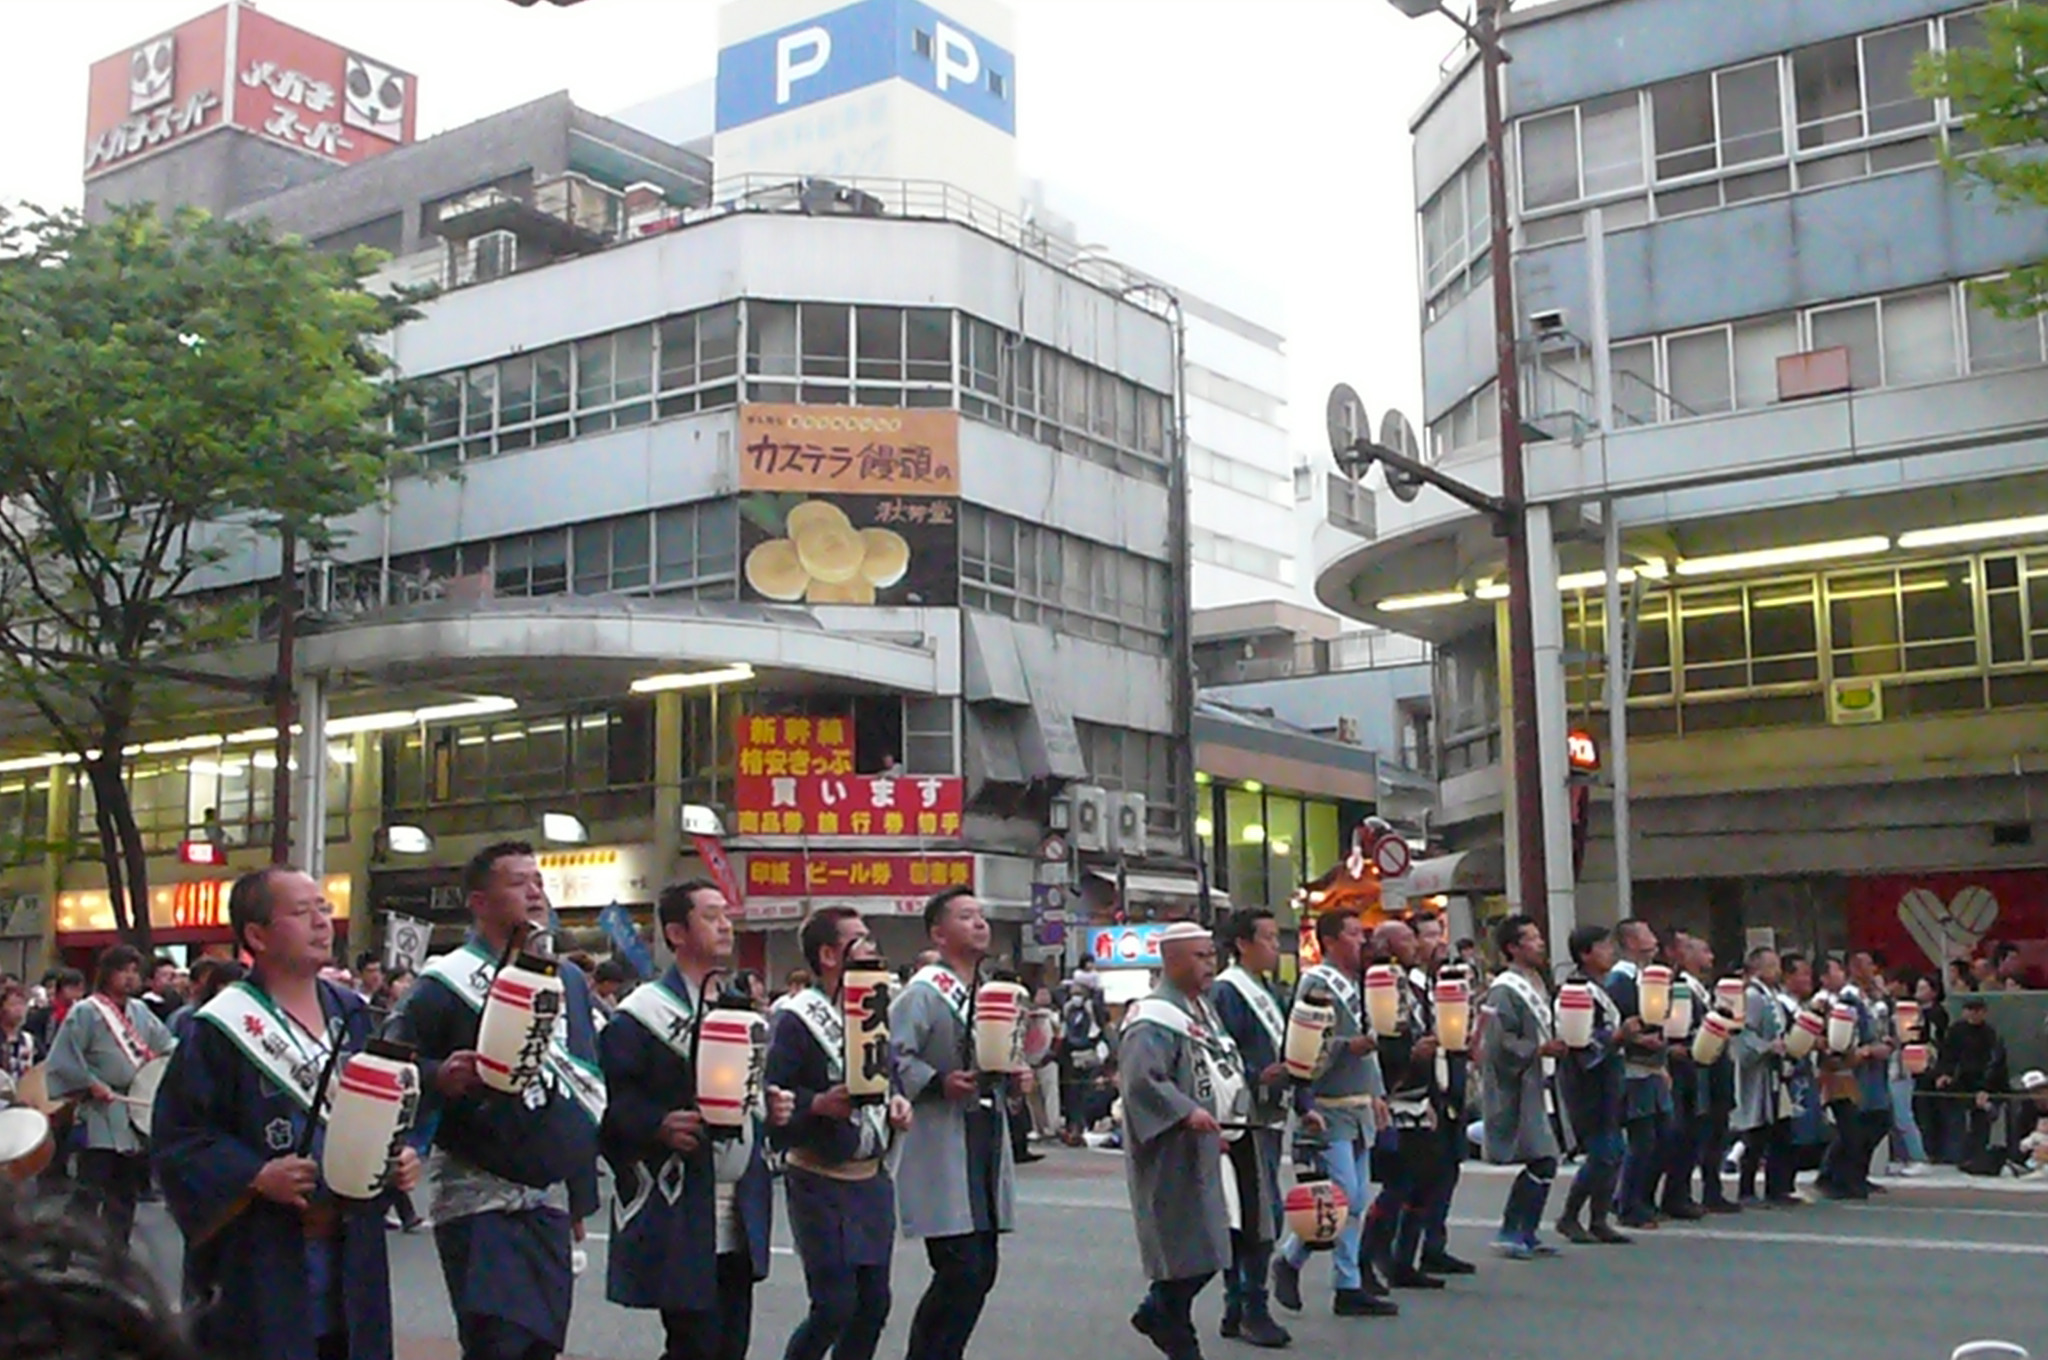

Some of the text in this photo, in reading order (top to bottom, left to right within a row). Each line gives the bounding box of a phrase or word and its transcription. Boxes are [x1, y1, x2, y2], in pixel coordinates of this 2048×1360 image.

[776, 26, 832, 105] P
[936, 21, 980, 92] P
[264, 104, 354, 155] スーパー
[746, 433, 951, 483] カステラ饅頭の
[750, 716, 844, 746] 新幹線
[740, 747, 852, 776] 格安きっぷ
[771, 777, 942, 807] 買います
[808, 861, 892, 885] ビール券
